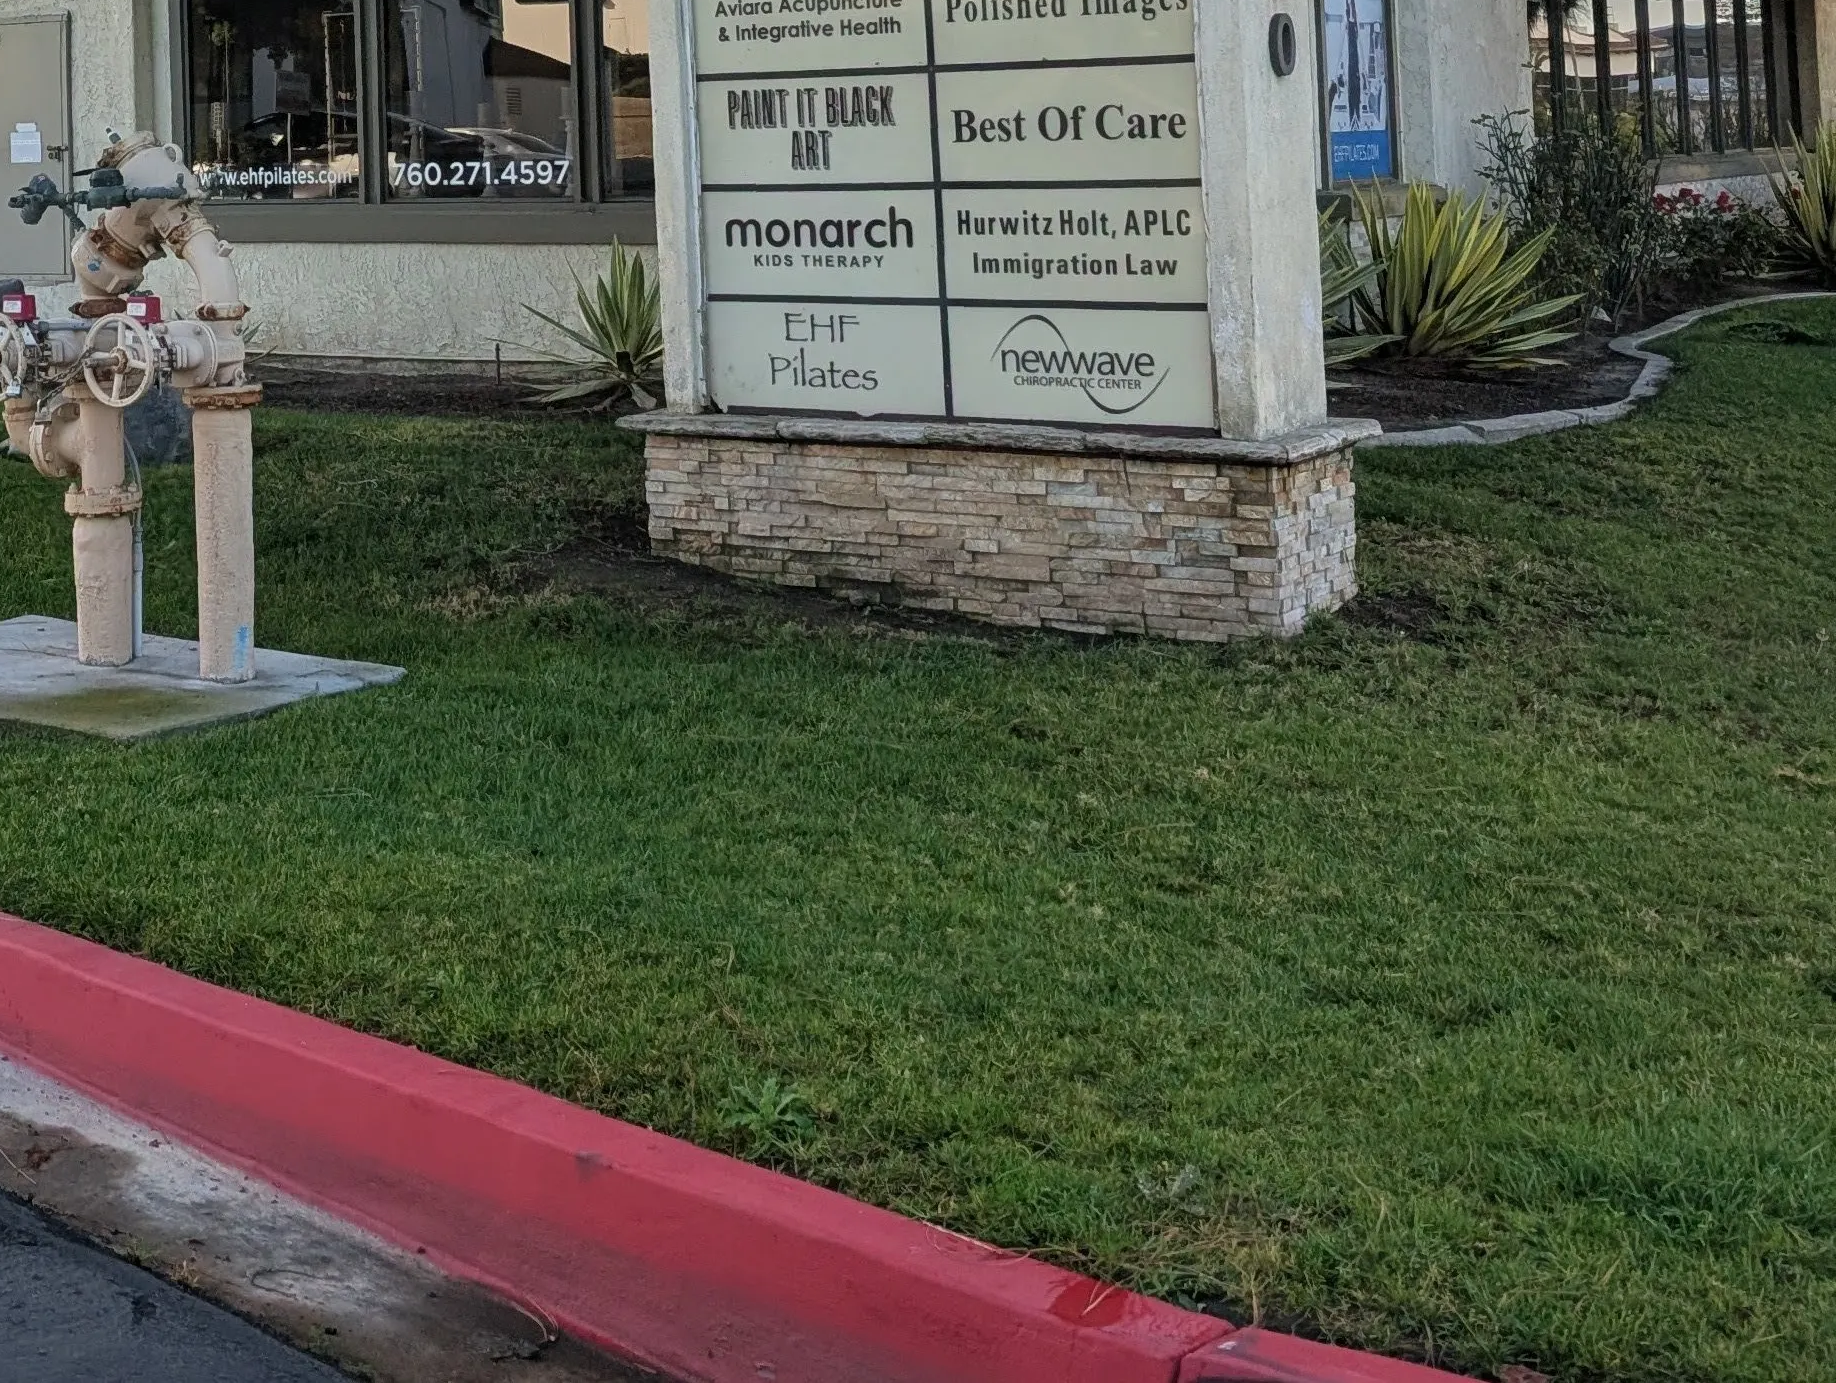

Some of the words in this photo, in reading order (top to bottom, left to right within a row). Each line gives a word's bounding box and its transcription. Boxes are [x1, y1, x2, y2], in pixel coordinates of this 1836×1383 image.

[718, 25, 730, 42] &
[735, 18, 834, 42] Integrative
[840, 15, 902, 38] Health
[727, 88, 790, 130] PAINT
[797, 87, 821, 128] IT
[825, 85, 896, 128] BLACK
[951, 107, 1026, 143] Best
[1038, 105, 1089, 140] Of
[1096, 103, 1187, 140] Care
[791, 130, 831, 171] ART
[393, 160, 569, 187] 760.271.4597
[725, 206, 914, 249] monarch
[957, 210, 1053, 237] Hurwitz
[1059, 210, 1117, 240] Holt,
[1124, 210, 1192, 237] APLC
[754, 253, 793, 269] KIDS
[801, 254, 884, 270] THERAPY
[973, 251, 1118, 279] Immigration
[1125, 253, 1178, 278] Law
[784, 312, 860, 344] EHF
[768, 349, 878, 392] Pilates
[1000, 347, 1154, 378] newwave
[1013, 375, 1095, 390] CHIROPRACTIC
[1097, 377, 1142, 390] CENTER
